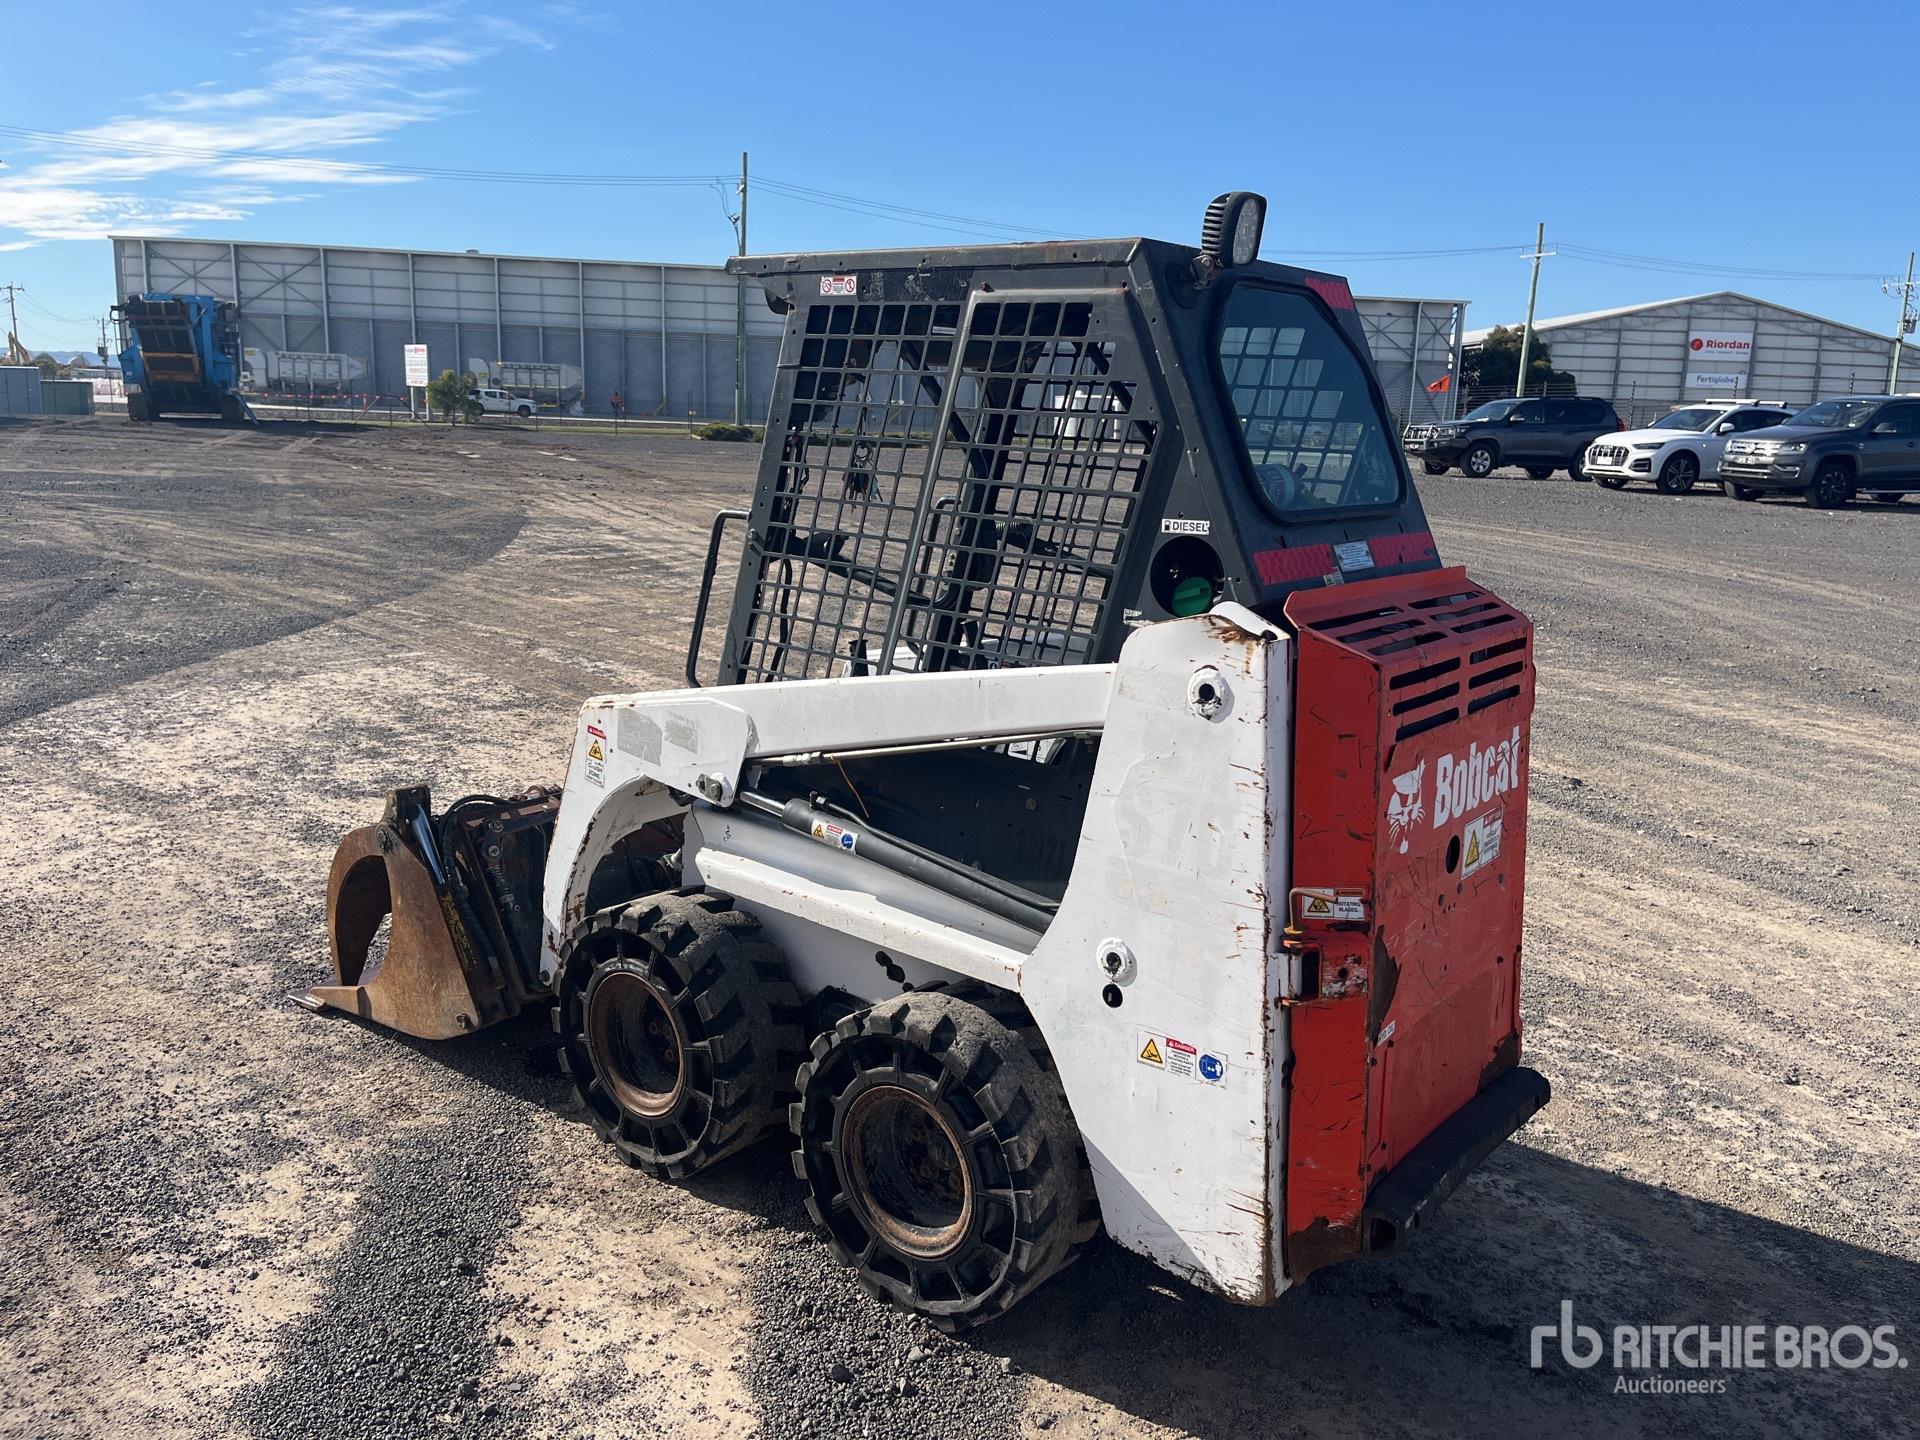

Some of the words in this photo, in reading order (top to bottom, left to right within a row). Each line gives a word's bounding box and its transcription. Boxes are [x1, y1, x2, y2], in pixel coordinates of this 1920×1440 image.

[1706, 340, 1750, 349] Riordan
[1172, 521, 1208, 532] DIESEL
[1433, 725, 1520, 829] Bobcat
[1174, 1042, 1195, 1053] DANGER
